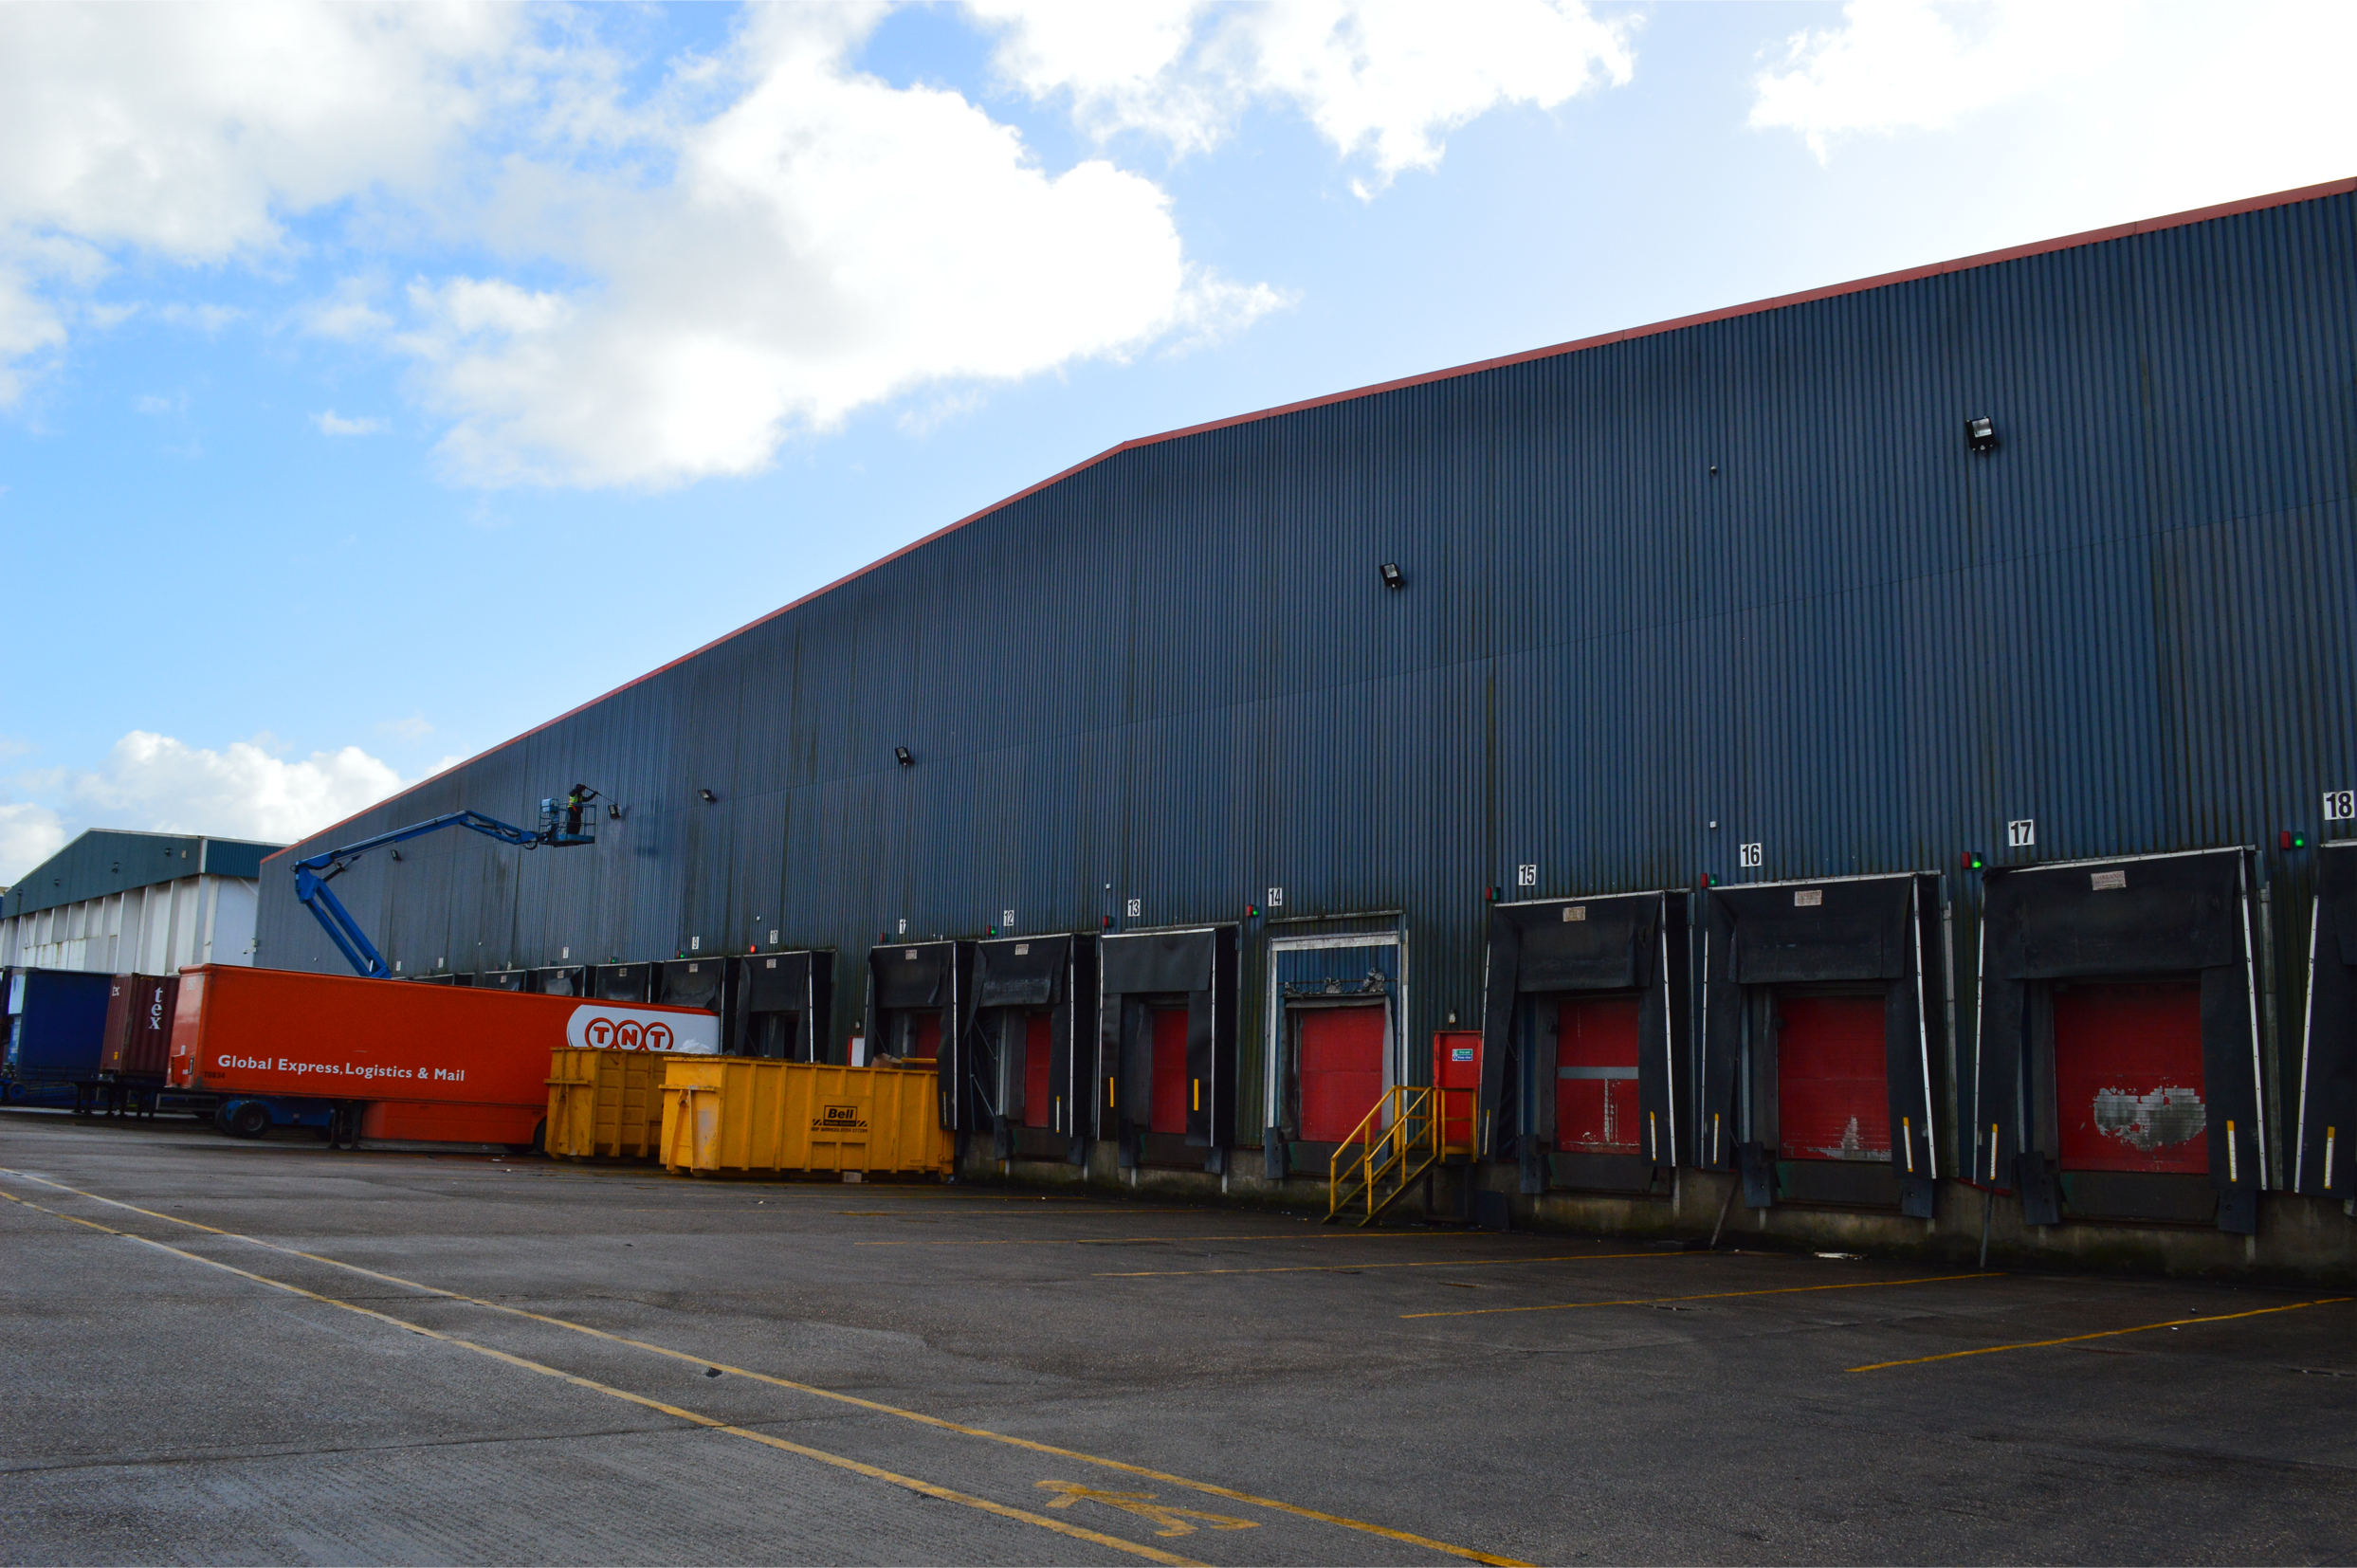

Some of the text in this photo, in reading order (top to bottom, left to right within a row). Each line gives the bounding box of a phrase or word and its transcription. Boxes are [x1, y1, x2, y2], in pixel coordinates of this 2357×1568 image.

[2326, 793, 2352, 818] 18
[2011, 822, 2032, 844] 17
[1743, 845, 1760, 865] 16
[1521, 866, 1534, 884] 15
[1270, 888, 1281, 905] 14
[1005, 911, 1014, 925] 12
[1129, 900, 1140, 916] 13
[148, 987, 163, 1030] tex
[593, 1026, 667, 1048] TNT
[218, 1054, 272, 1069] Global
[345, 1063, 412, 1079] Logistics
[417, 1067, 429, 1079] &
[434, 1068, 465, 1081] Mail
[828, 1108, 853, 1119] Bell
